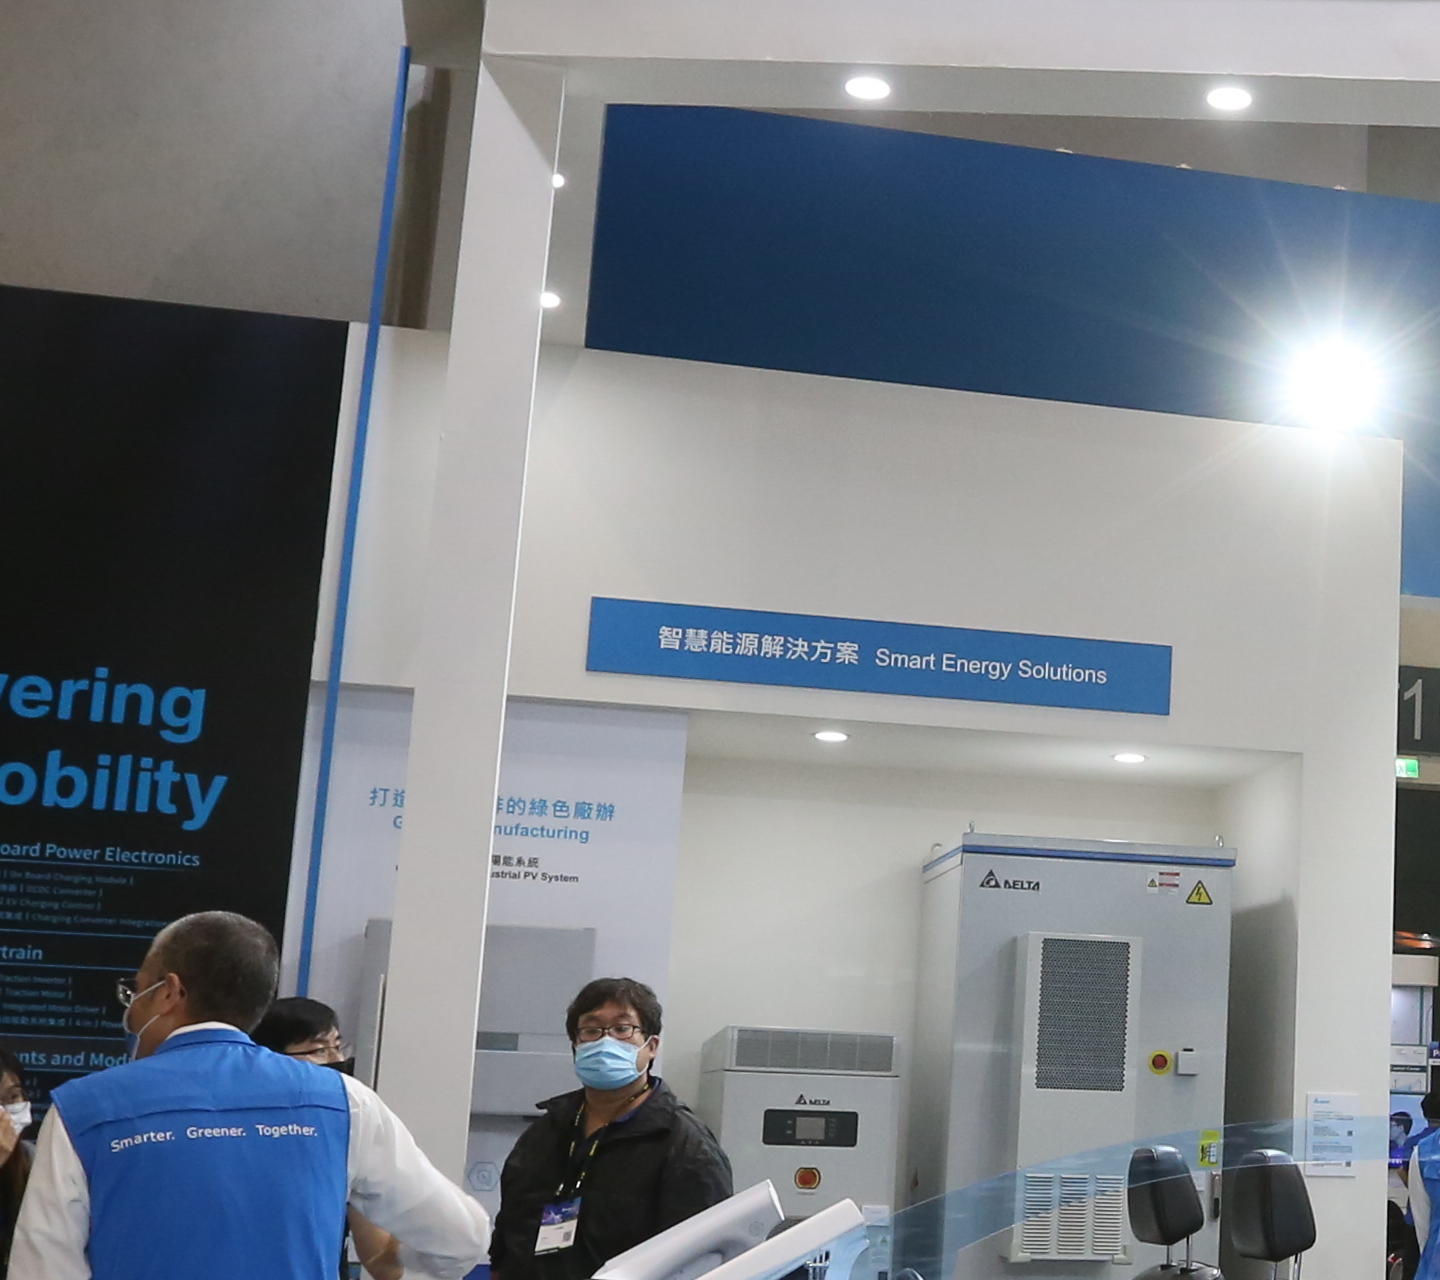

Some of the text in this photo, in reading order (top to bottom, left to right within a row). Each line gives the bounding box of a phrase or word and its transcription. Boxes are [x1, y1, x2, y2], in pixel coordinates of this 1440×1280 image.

[657, 625, 860, 666] 智慧能源解決方案
[875, 647, 1108, 685] Smart Energy Solutions
[493, 824, 590, 844] nufacturing
[45, 843, 100, 862] Power
[104, 847, 201, 867] Electronics
[540, 872, 579, 884] System
[1003, 878, 1040, 891] DELTA
[50, 1050, 85, 1067] and
[110, 1123, 318, 1153] Smarter. Greener. Together.
